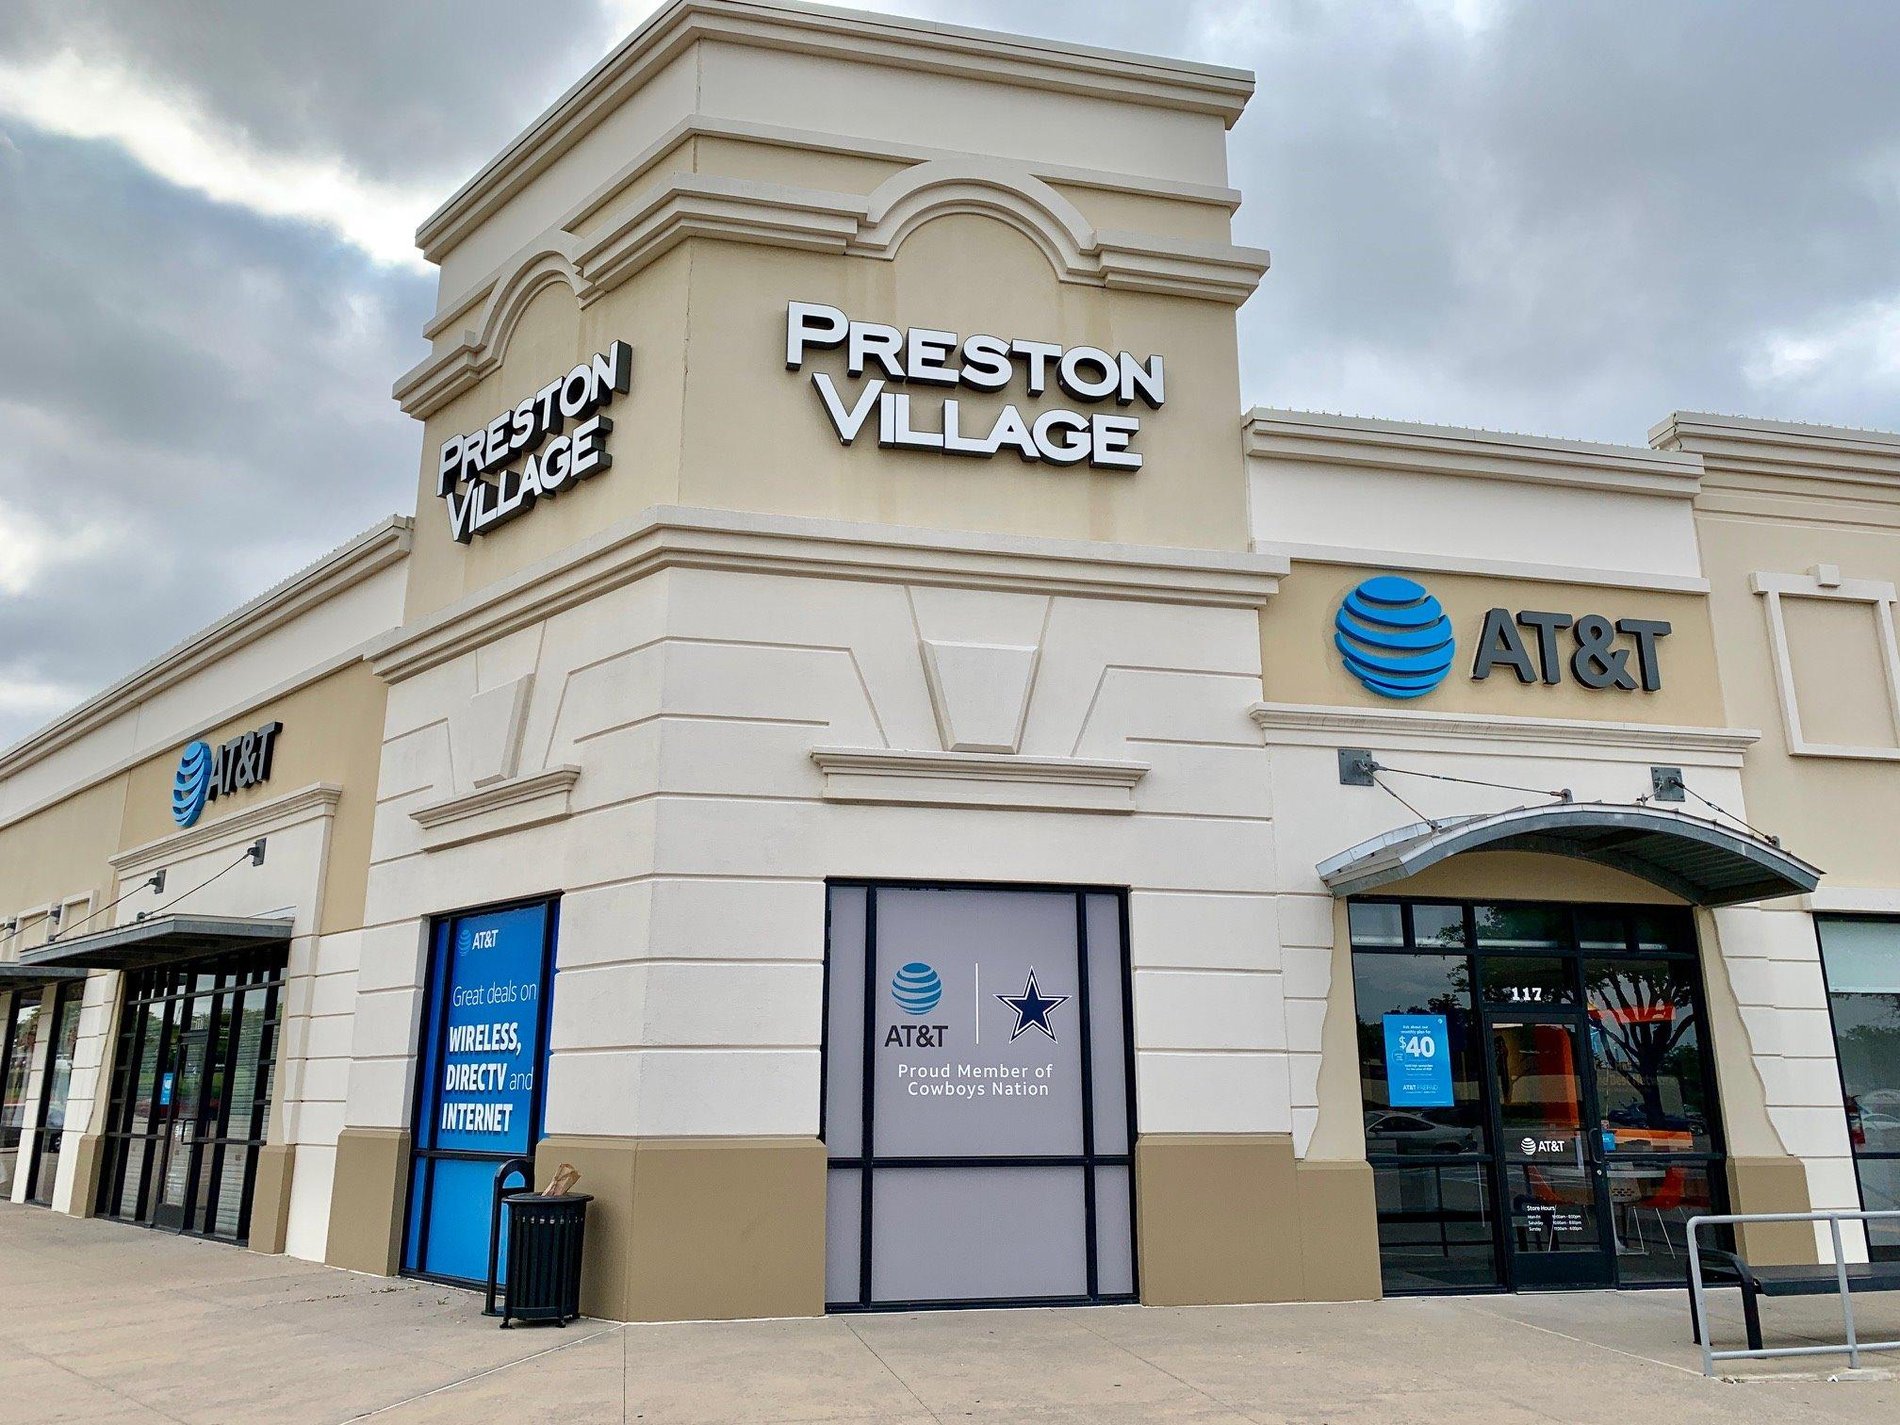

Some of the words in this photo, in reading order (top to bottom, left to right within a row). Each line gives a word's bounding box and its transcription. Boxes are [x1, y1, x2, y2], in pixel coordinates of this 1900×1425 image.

[786, 300, 1165, 410] PRESTON
[436, 339, 633, 498] PRESTON
[811, 371, 1144, 473] VILLAGE
[446, 414, 614, 545] VILLAGE
[1470, 607, 1673, 693] AT&T
[204, 721, 284, 803] AT&T
[471, 929, 499, 951] AT&T
[452, 985, 485, 1007] Great
[486, 979, 518, 1004] deals
[520, 983, 537, 1002] on
[1511, 986, 1542, 1001] 117
[449, 1022, 522, 1056] WIRELESS,
[884, 1024, 949, 1048] AT&T
[1398, 1035, 1436, 1058] $40
[445, 1062, 508, 1092] DIRECTV
[509, 1065, 534, 1092] and
[897, 1063, 951, 1079] Proud
[957, 1063, 1028, 1079] Member
[1035, 1063, 1054, 1079] of
[907, 1081, 986, 1100] Cowboys
[991, 1081, 1050, 1096] Nation
[441, 1102, 514, 1132] INTERNET
[1538, 1140, 1565, 1153] AT&T
